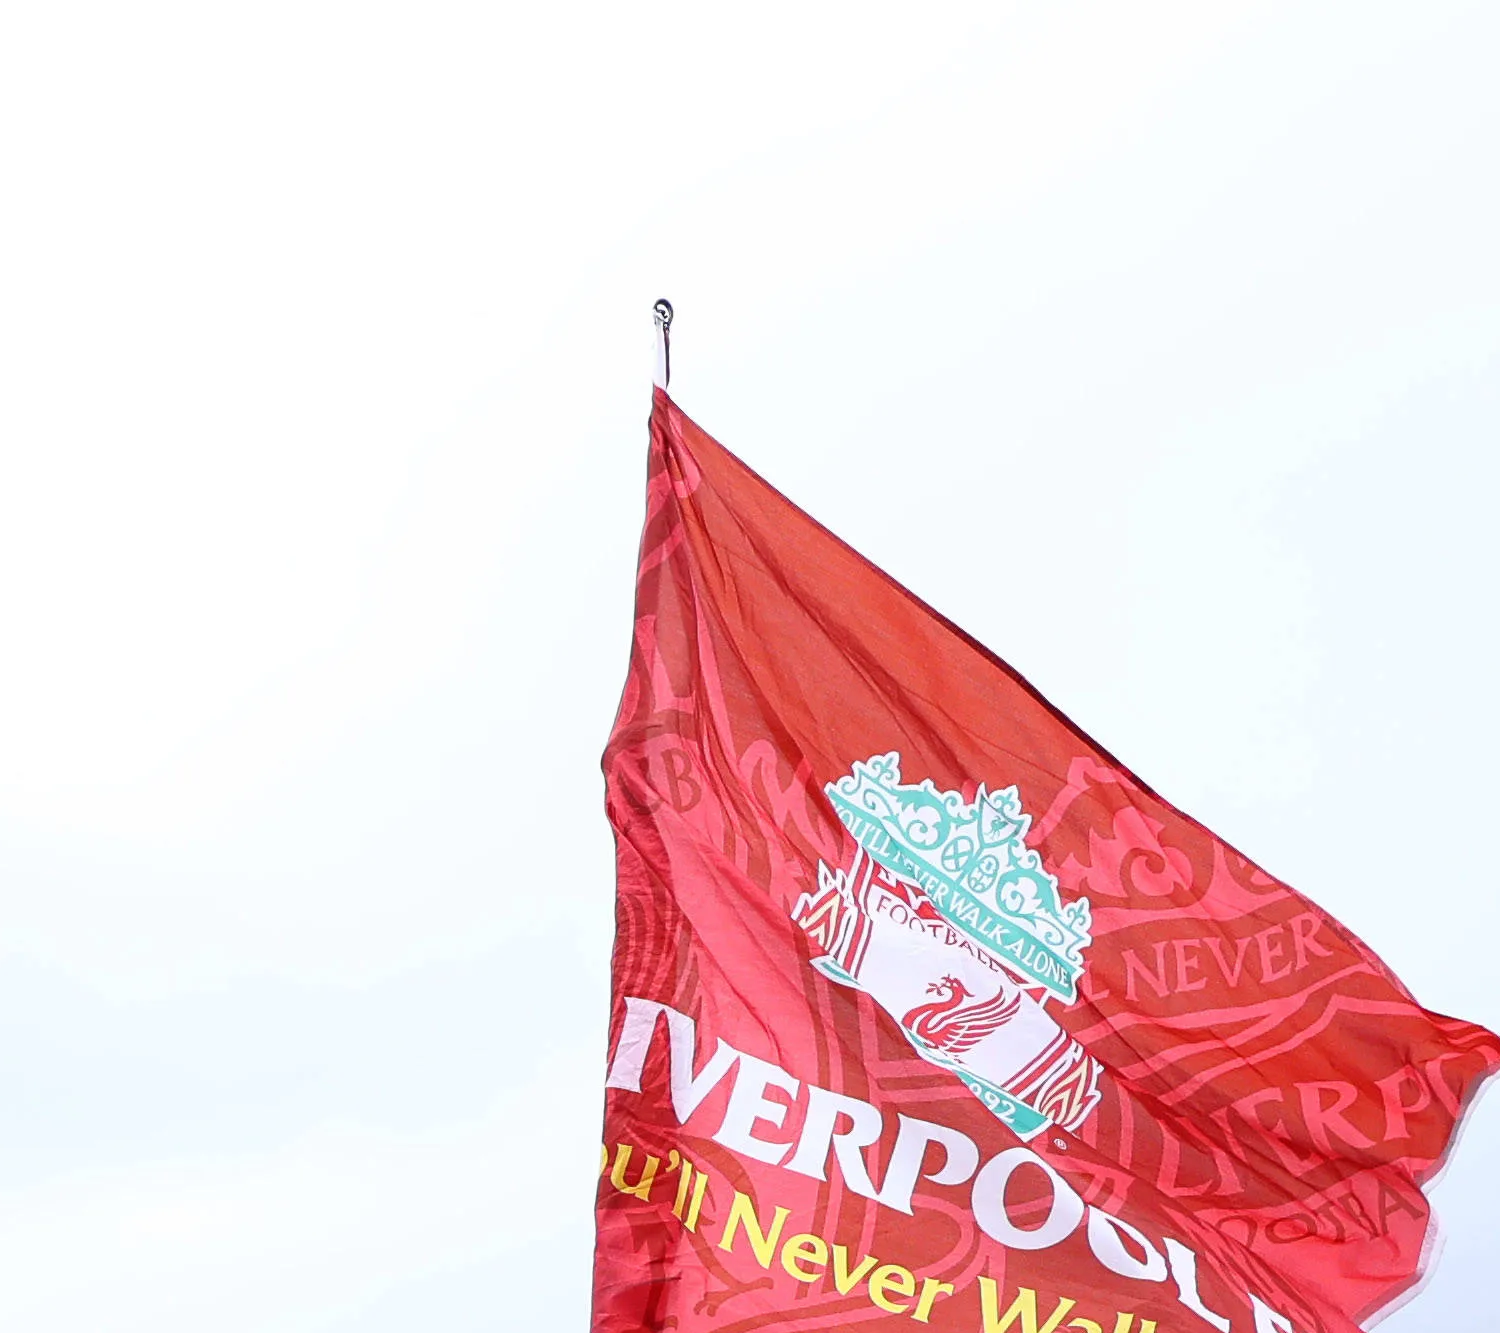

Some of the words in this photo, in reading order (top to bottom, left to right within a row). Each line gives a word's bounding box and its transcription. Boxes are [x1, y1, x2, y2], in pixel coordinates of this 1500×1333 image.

[949, 892, 1015, 947] WALK
[1007, 932, 1070, 990] ALONE
[1121, 913, 1333, 1001] NEVER
[718, 1190, 956, 1322] Never
